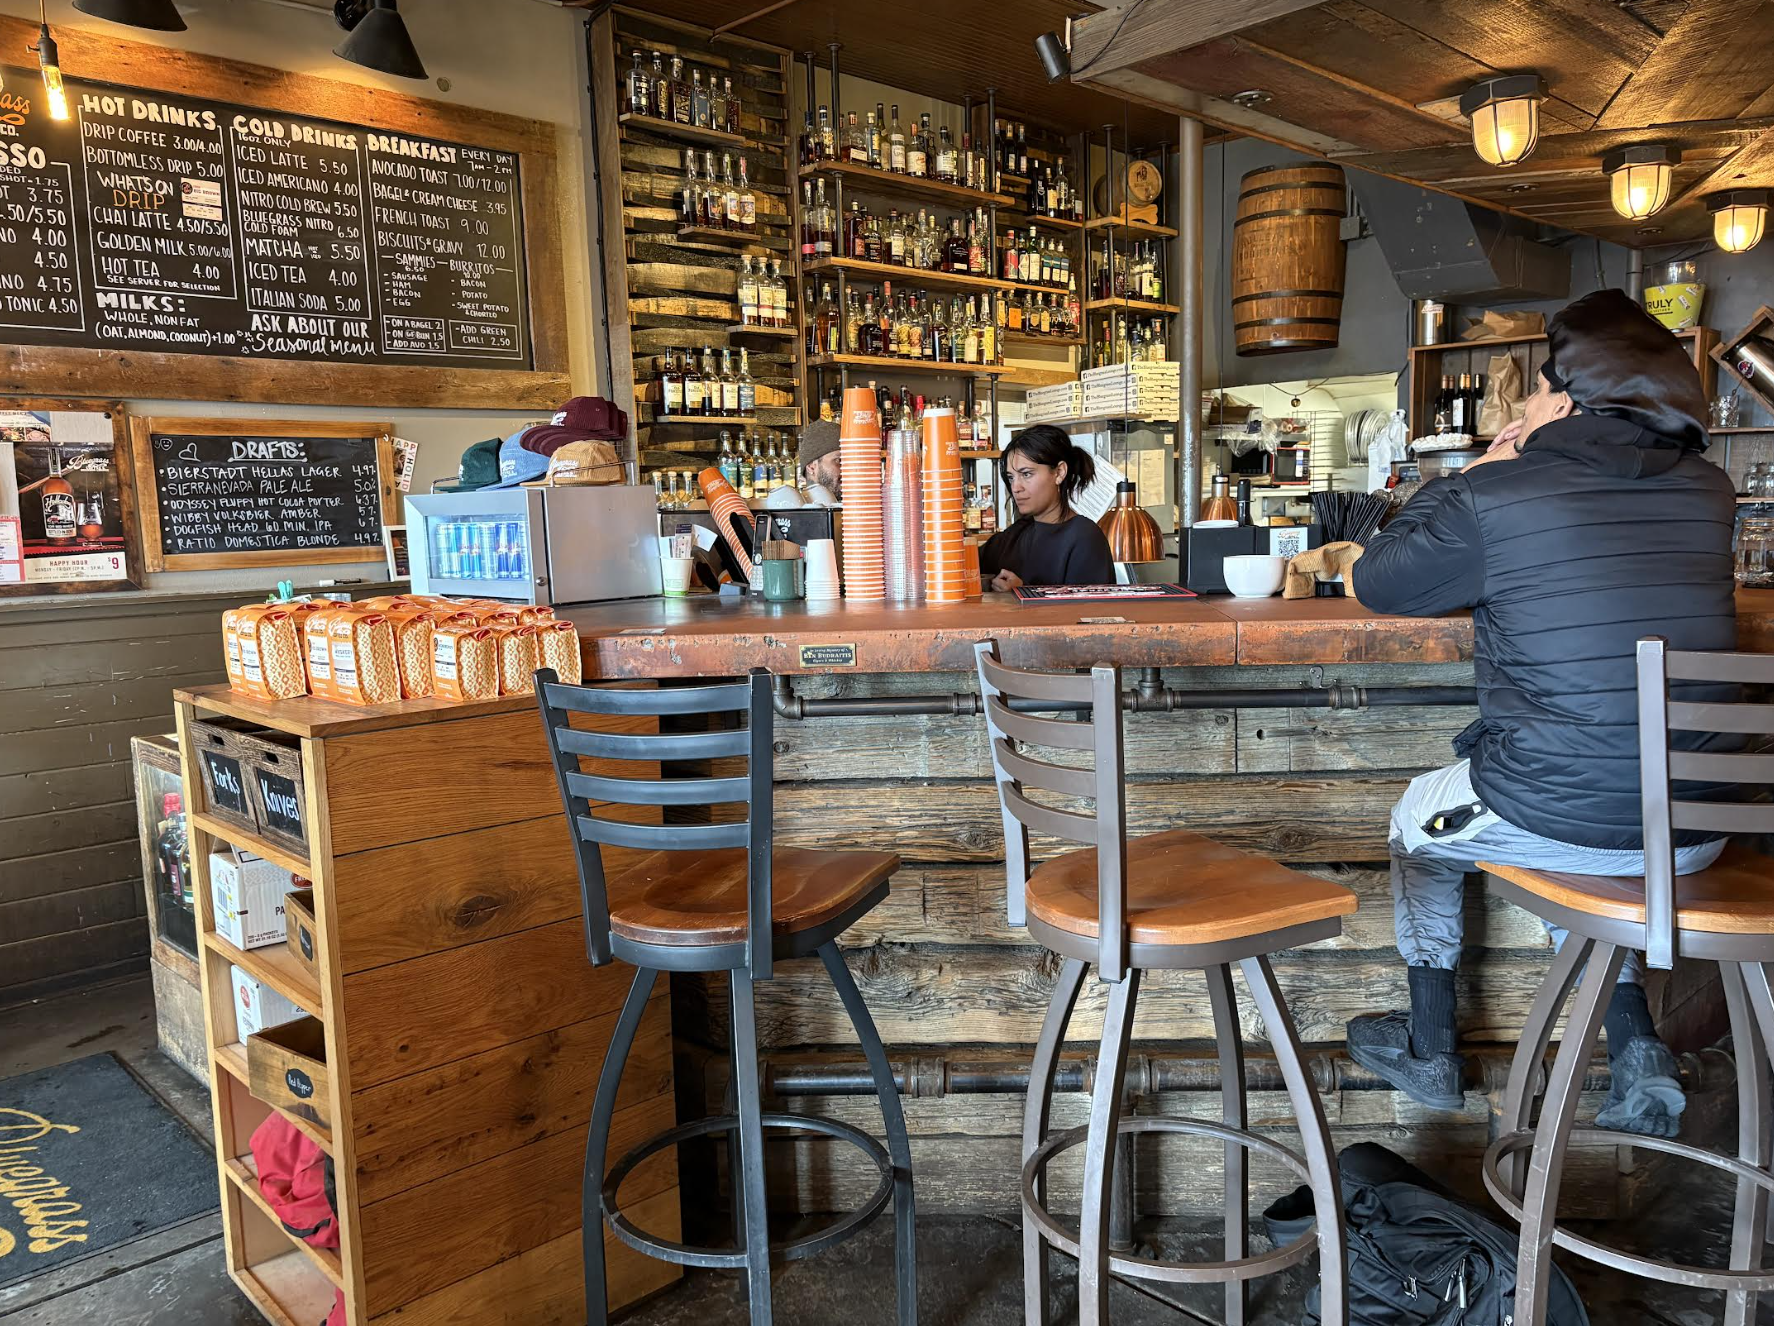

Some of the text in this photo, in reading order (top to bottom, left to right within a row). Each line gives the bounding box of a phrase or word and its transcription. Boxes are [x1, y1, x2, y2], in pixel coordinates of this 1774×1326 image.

[82, 94, 216, 130] HOT DRINKS
[84, 122, 115, 140] DRIP
[118, 128, 166, 148] COFFEE
[233, 115, 357, 150] COLD DRINKS
[264, 136, 291, 148] ONLY
[367, 133, 513, 166] BREAKFAST EVERY DAY
[86, 146, 224, 178] BOTTOMLESS DRIP 5.00
[237, 144, 348, 176] ICED LATTE 5.50
[238, 166, 358, 196] ICED AMERICANO 4.00
[372, 158, 416, 180] AVOCADO
[418, 167, 448, 186] TOAST
[27, 187, 64, 205] 3.75
[155, 180, 174, 196] ON
[113, 190, 165, 210] DRIP
[242, 190, 274, 208] NITRO
[276, 194, 301, 212] COLD
[303, 198, 331, 214] BREW
[334, 202, 358, 218] 5.50
[372, 182, 406, 202] BAGEL
[412, 190, 446, 208] CREAM
[446, 196, 478, 212] CHEESE
[486, 202, 507, 215] 3.95
[94, 206, 228, 238] CHAI LATTE 4.50/5.50
[242, 210, 334, 232] BLUEGRASS NITRO
[244, 222, 360, 238] COLD FOAM 6.50
[375, 206, 489, 235] FRENCH TOAST 9.00
[32, 227, 67, 247] 4.00
[97, 232, 152, 252] GOLDEN
[154, 238, 188, 257] MILK
[378, 230, 426, 251] BISCUITS
[432, 238, 463, 256] GRAVY
[476, 242, 506, 260] 12.00
[246, 238, 360, 261] MATCHA 5.50
[34, 251, 68, 269] 4.50
[102, 256, 220, 280] HOT TEA 4.00
[395, 252, 495, 275] SAMMIES BURRITOS
[106, 274, 221, 291] SEE SERVER FOR SELECTION
[248, 260, 358, 286] ICED TEA 4.00
[391, 272, 428, 282] SAUSAGE
[37, 275, 72, 293] 4.75
[460, 280, 486, 288] BACON
[251, 288, 361, 312] ITALIAN SODA 5.00
[392, 290, 421, 298] BACON
[392, 298, 411, 306] EGG
[462, 290, 488, 300] POTATO
[4, 296, 78, 314] TONIC 4.50
[457, 302, 510, 313] SWEET POTATO
[1646, 298, 1674, 312] TRULY
[251, 314, 370, 339] ASK ABOUT OUR
[392, 319, 403, 328] ON
[411, 320, 434, 330] BAGEL
[460, 324, 507, 336] ADD GREEN
[251, 332, 378, 356] Seasonal menu
[392, 330, 404, 338] ON
[416, 332, 430, 340] BUN
[392, 340, 408, 348] ADD
[490, 336, 511, 346] 2.50
[167, 466, 247, 480] BIERSTADT
[252, 467, 294, 478] HELLAS
[301, 466, 342, 478] LAGER
[260, 480, 288, 494] PALE
[290, 479, 314, 492] ALE
[170, 496, 344, 510] ODYSSEY FLUFFY HOT COCOA PORTER
[171, 508, 322, 524] WIBBY VOLKSBIER AMBER
[173, 524, 222, 536] DOGFISH
[228, 522, 259, 533] HEAD
[266, 522, 280, 533] 60
[315, 520, 332, 531] IPA
[177, 538, 216, 550] RATIO
[224, 535, 290, 548] DOMESTICA
[296, 534, 340, 547] BLONDE
[210, 760, 240, 796] Forks
[260, 778, 301, 822] Knives
